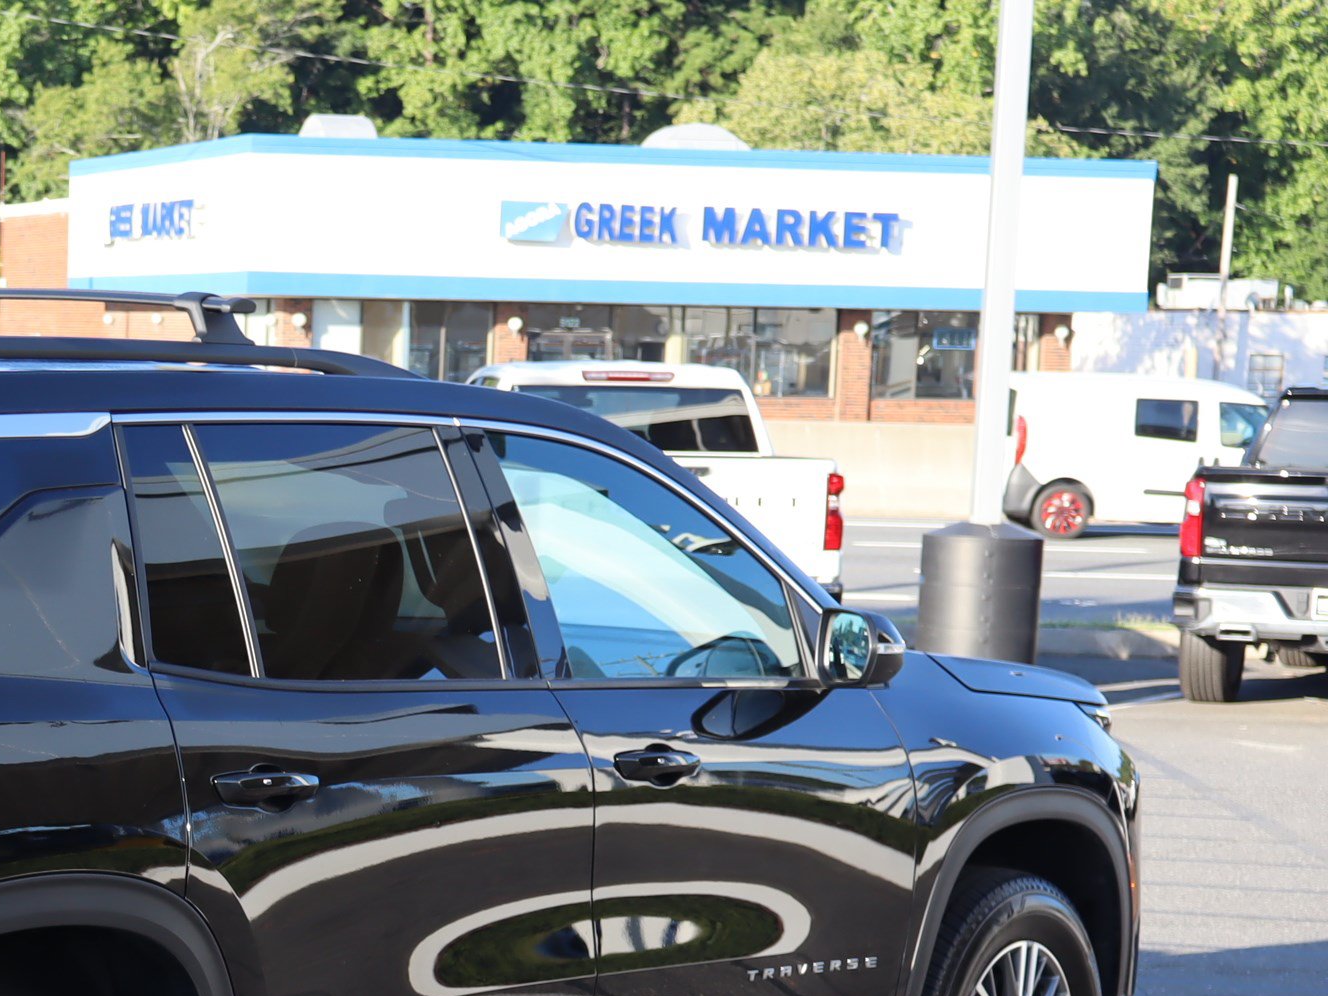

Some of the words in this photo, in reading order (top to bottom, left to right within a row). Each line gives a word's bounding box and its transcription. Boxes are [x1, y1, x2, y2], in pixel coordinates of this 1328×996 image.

[574, 202, 678, 244] GREEK
[702, 206, 900, 250] MARKET
[746, 956, 878, 982] TRAVERSE
